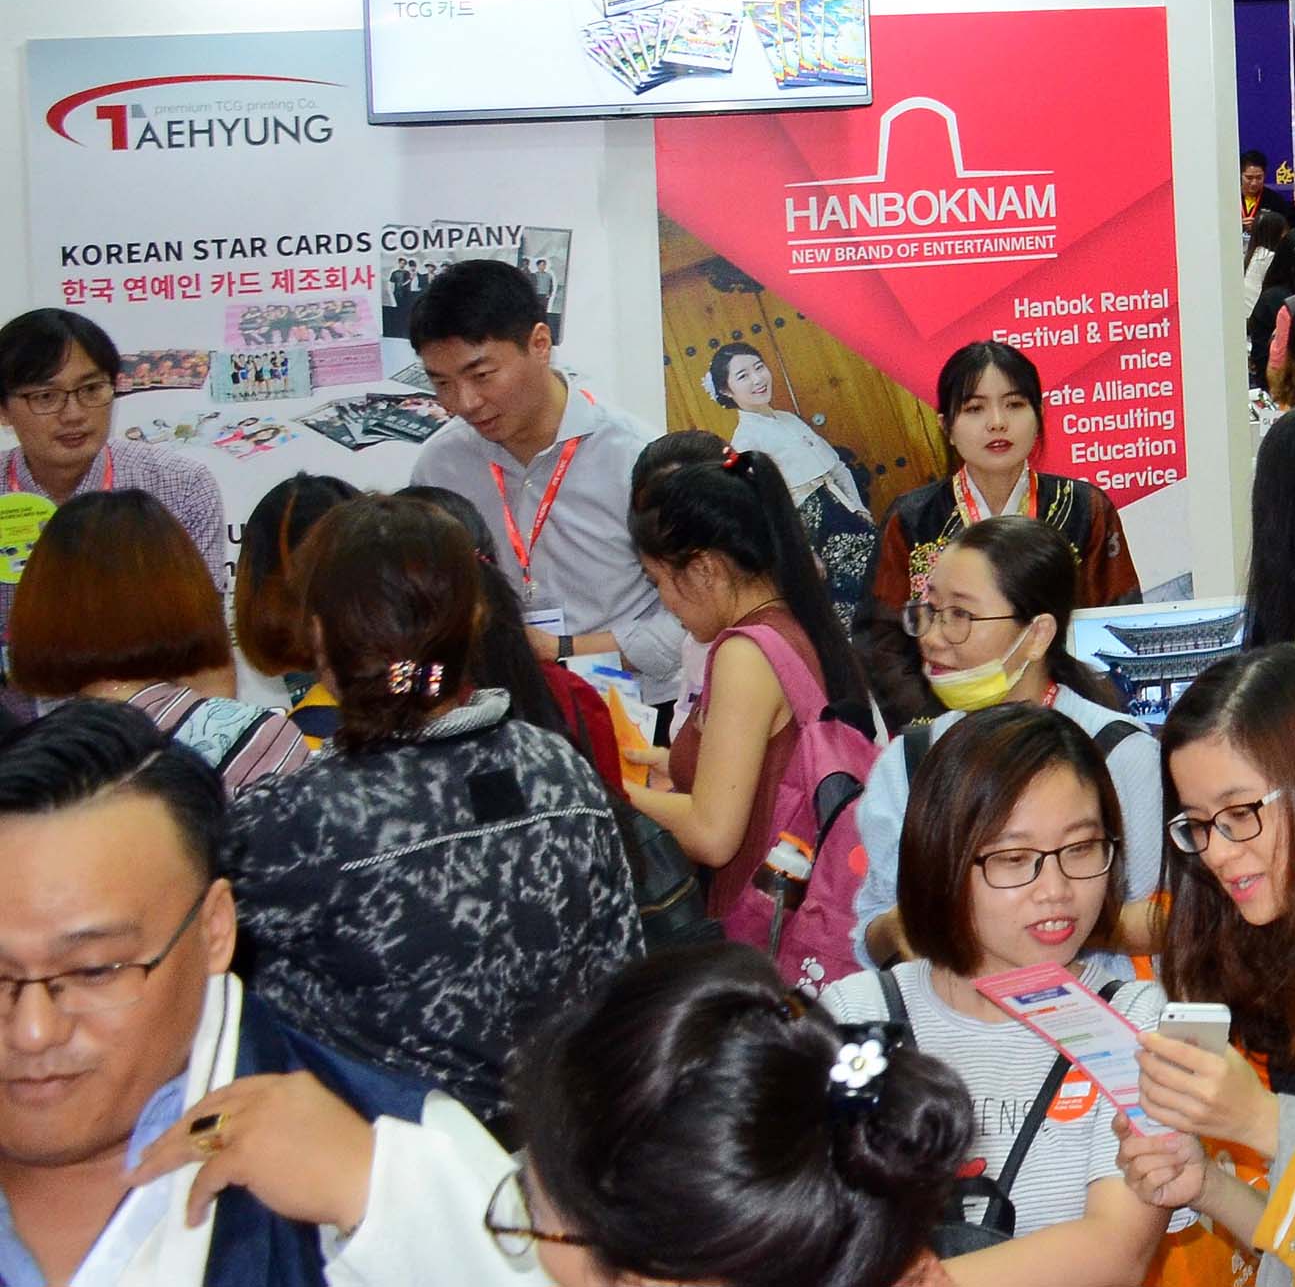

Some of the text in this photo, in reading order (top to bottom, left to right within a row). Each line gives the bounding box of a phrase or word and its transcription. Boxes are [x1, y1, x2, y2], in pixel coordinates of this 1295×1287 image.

[393, 0, 475, 19] TCG 카드
[154, 103, 213, 115] premium
[215, 101, 243, 112] TCG
[247, 99, 294, 112] printing
[96, 104, 334, 150] TAEHYUNG
[785, 183, 1057, 232] HANBOKNAM
[60, 224, 523, 267] KOREAN STAR CARDS COMPANY
[791, 234, 1056, 264] NEW BRAND OF ENTERTAINMENT
[60, 265, 375, 306] 한국 연예인 카드 제조회사
[1014, 288, 1169, 319] Hanbok Rental
[992, 317, 1170, 350] Festival & Event
[1120, 348, 1172, 371] mice
[1092, 380, 1173, 402] Alliance
[1062, 409, 1175, 435] Consulting
[1071, 437, 1176, 464] Education
[1096, 466, 1178, 491] Service
